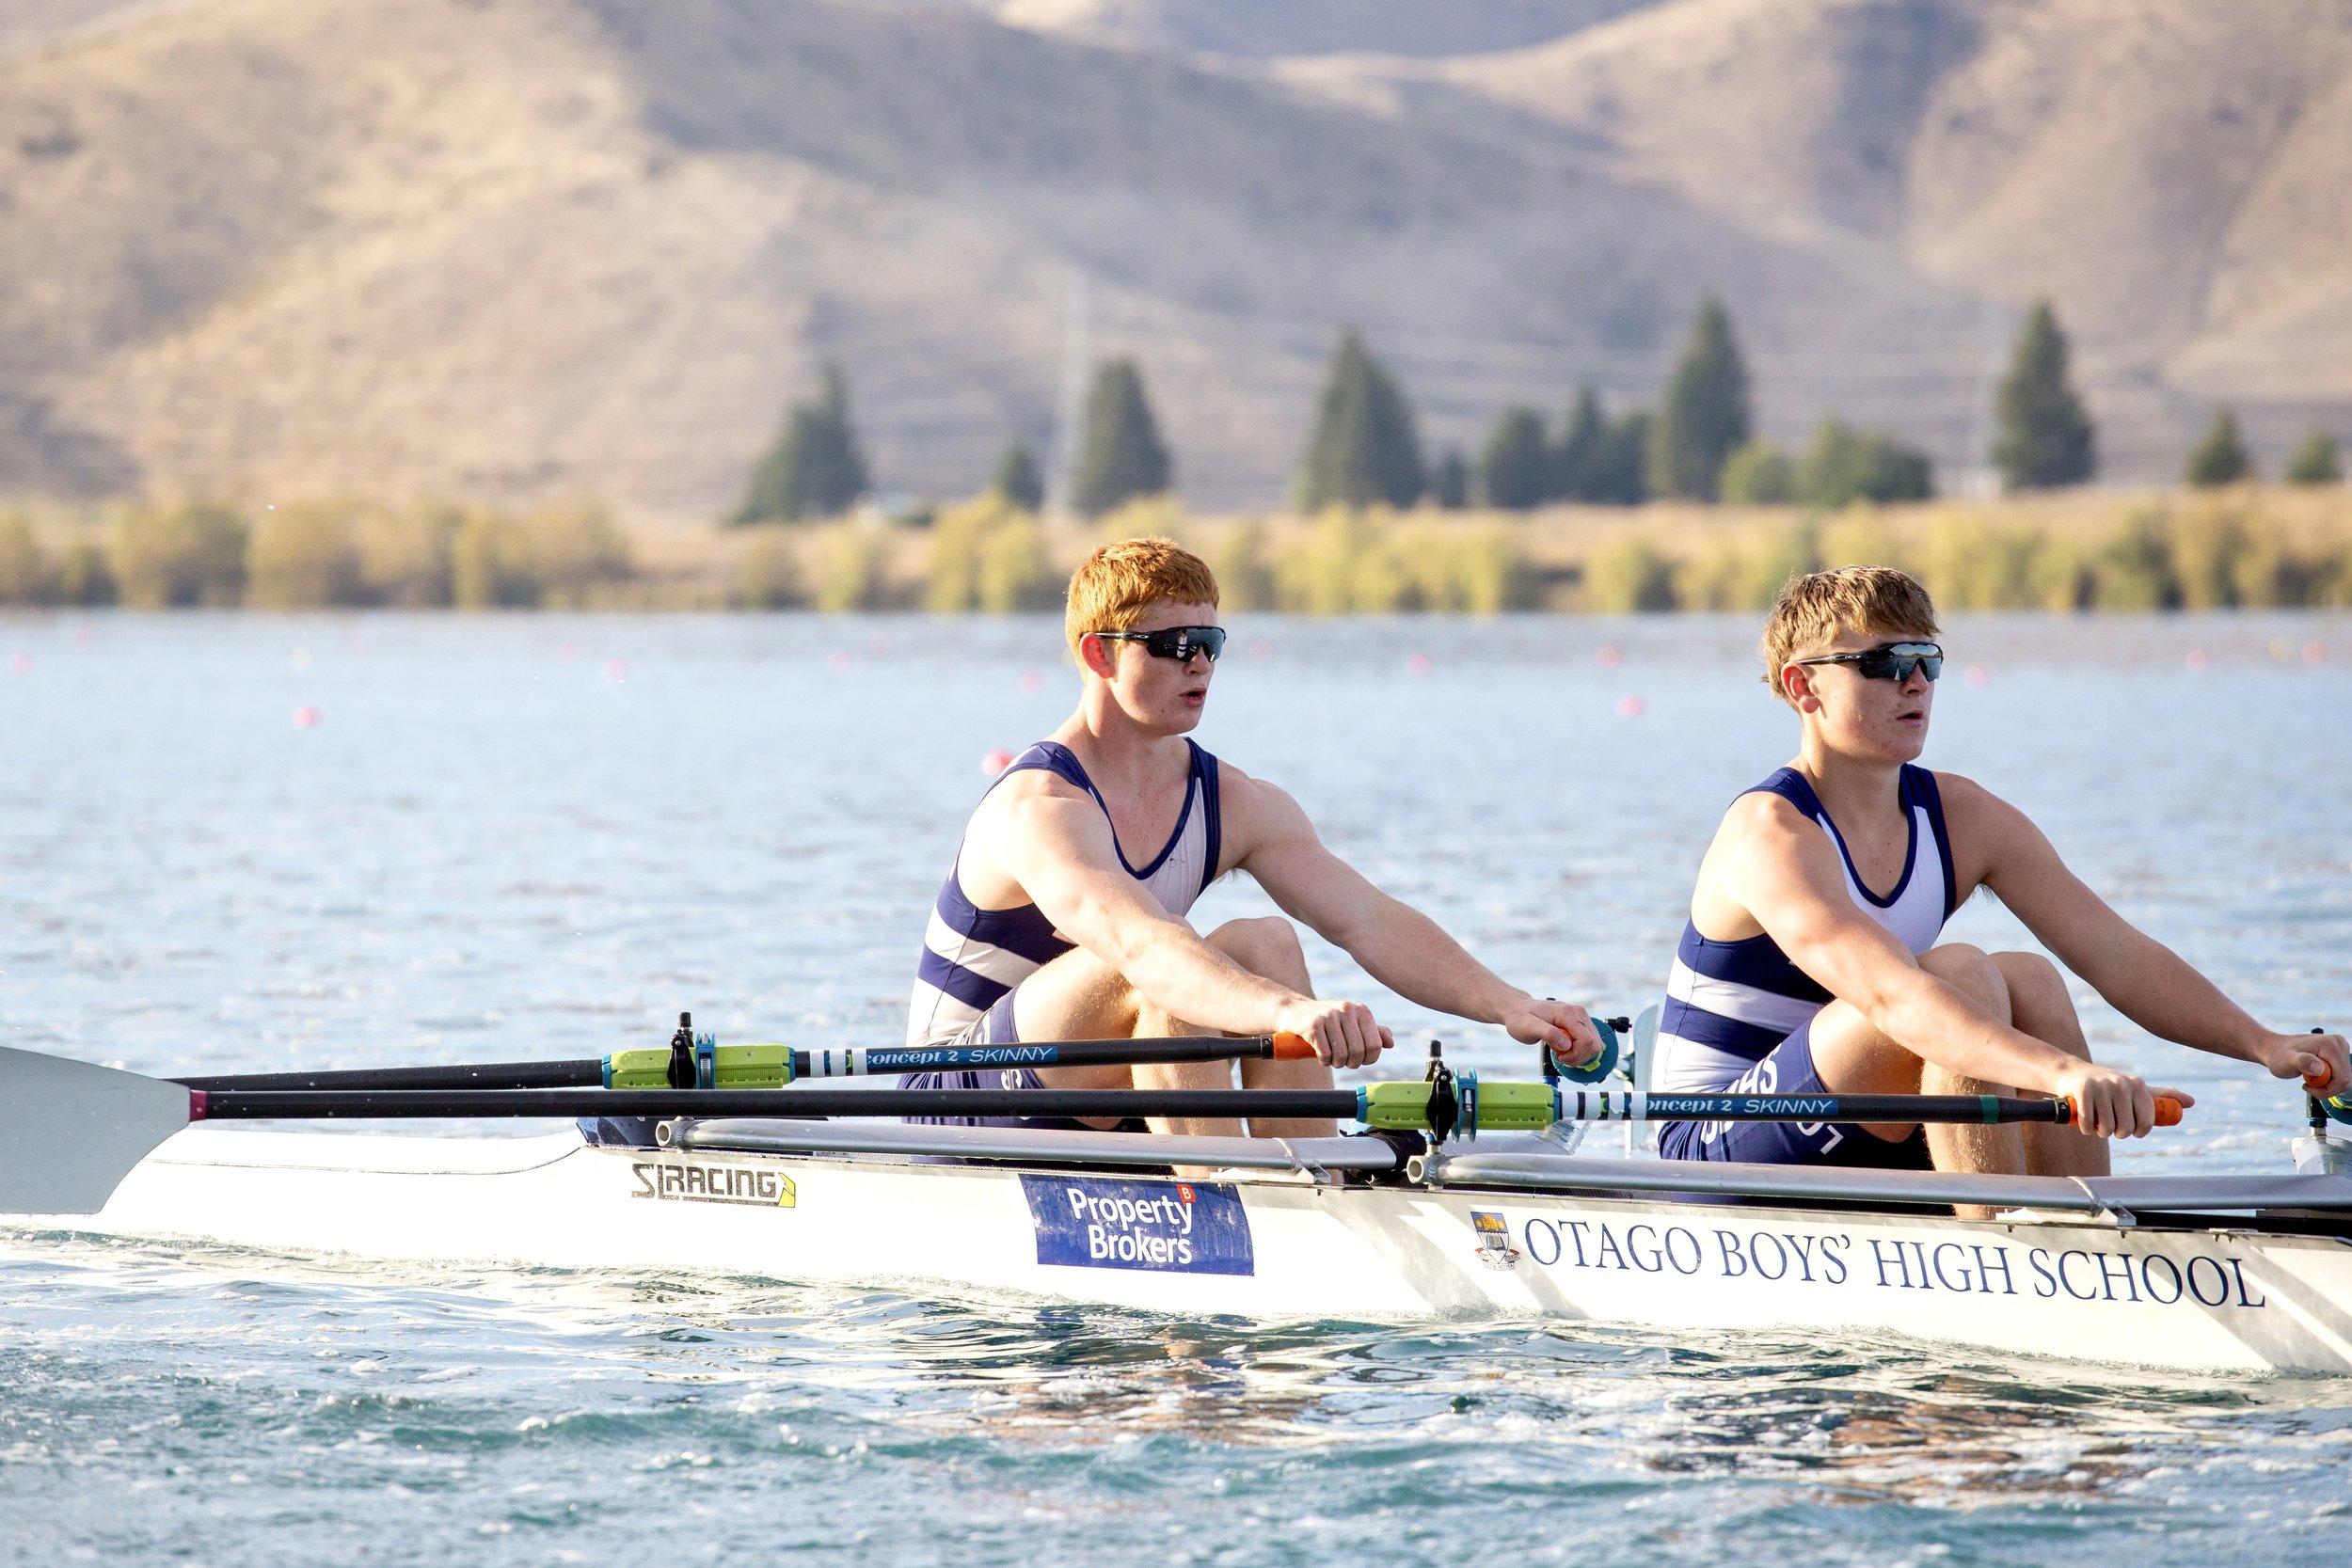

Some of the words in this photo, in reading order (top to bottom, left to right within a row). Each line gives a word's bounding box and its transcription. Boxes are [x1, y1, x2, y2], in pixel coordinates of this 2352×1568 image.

[947, 1051, 959, 1062] 2
[969, 1047, 1054, 1063] SKINNY
[1646, 1099, 1714, 1113] oncept
[1721, 1100, 1733, 1112] 2
[1743, 1100, 1834, 1114] SKINNY
[1067, 1188, 1192, 1235] Property
[1088, 1225, 1192, 1264] Brokers
[1525, 1218, 1702, 1275] OTAGO
[1867, 1239, 2018, 1294] HIGH
[2028, 1247, 2265, 1307] SCHOOL
